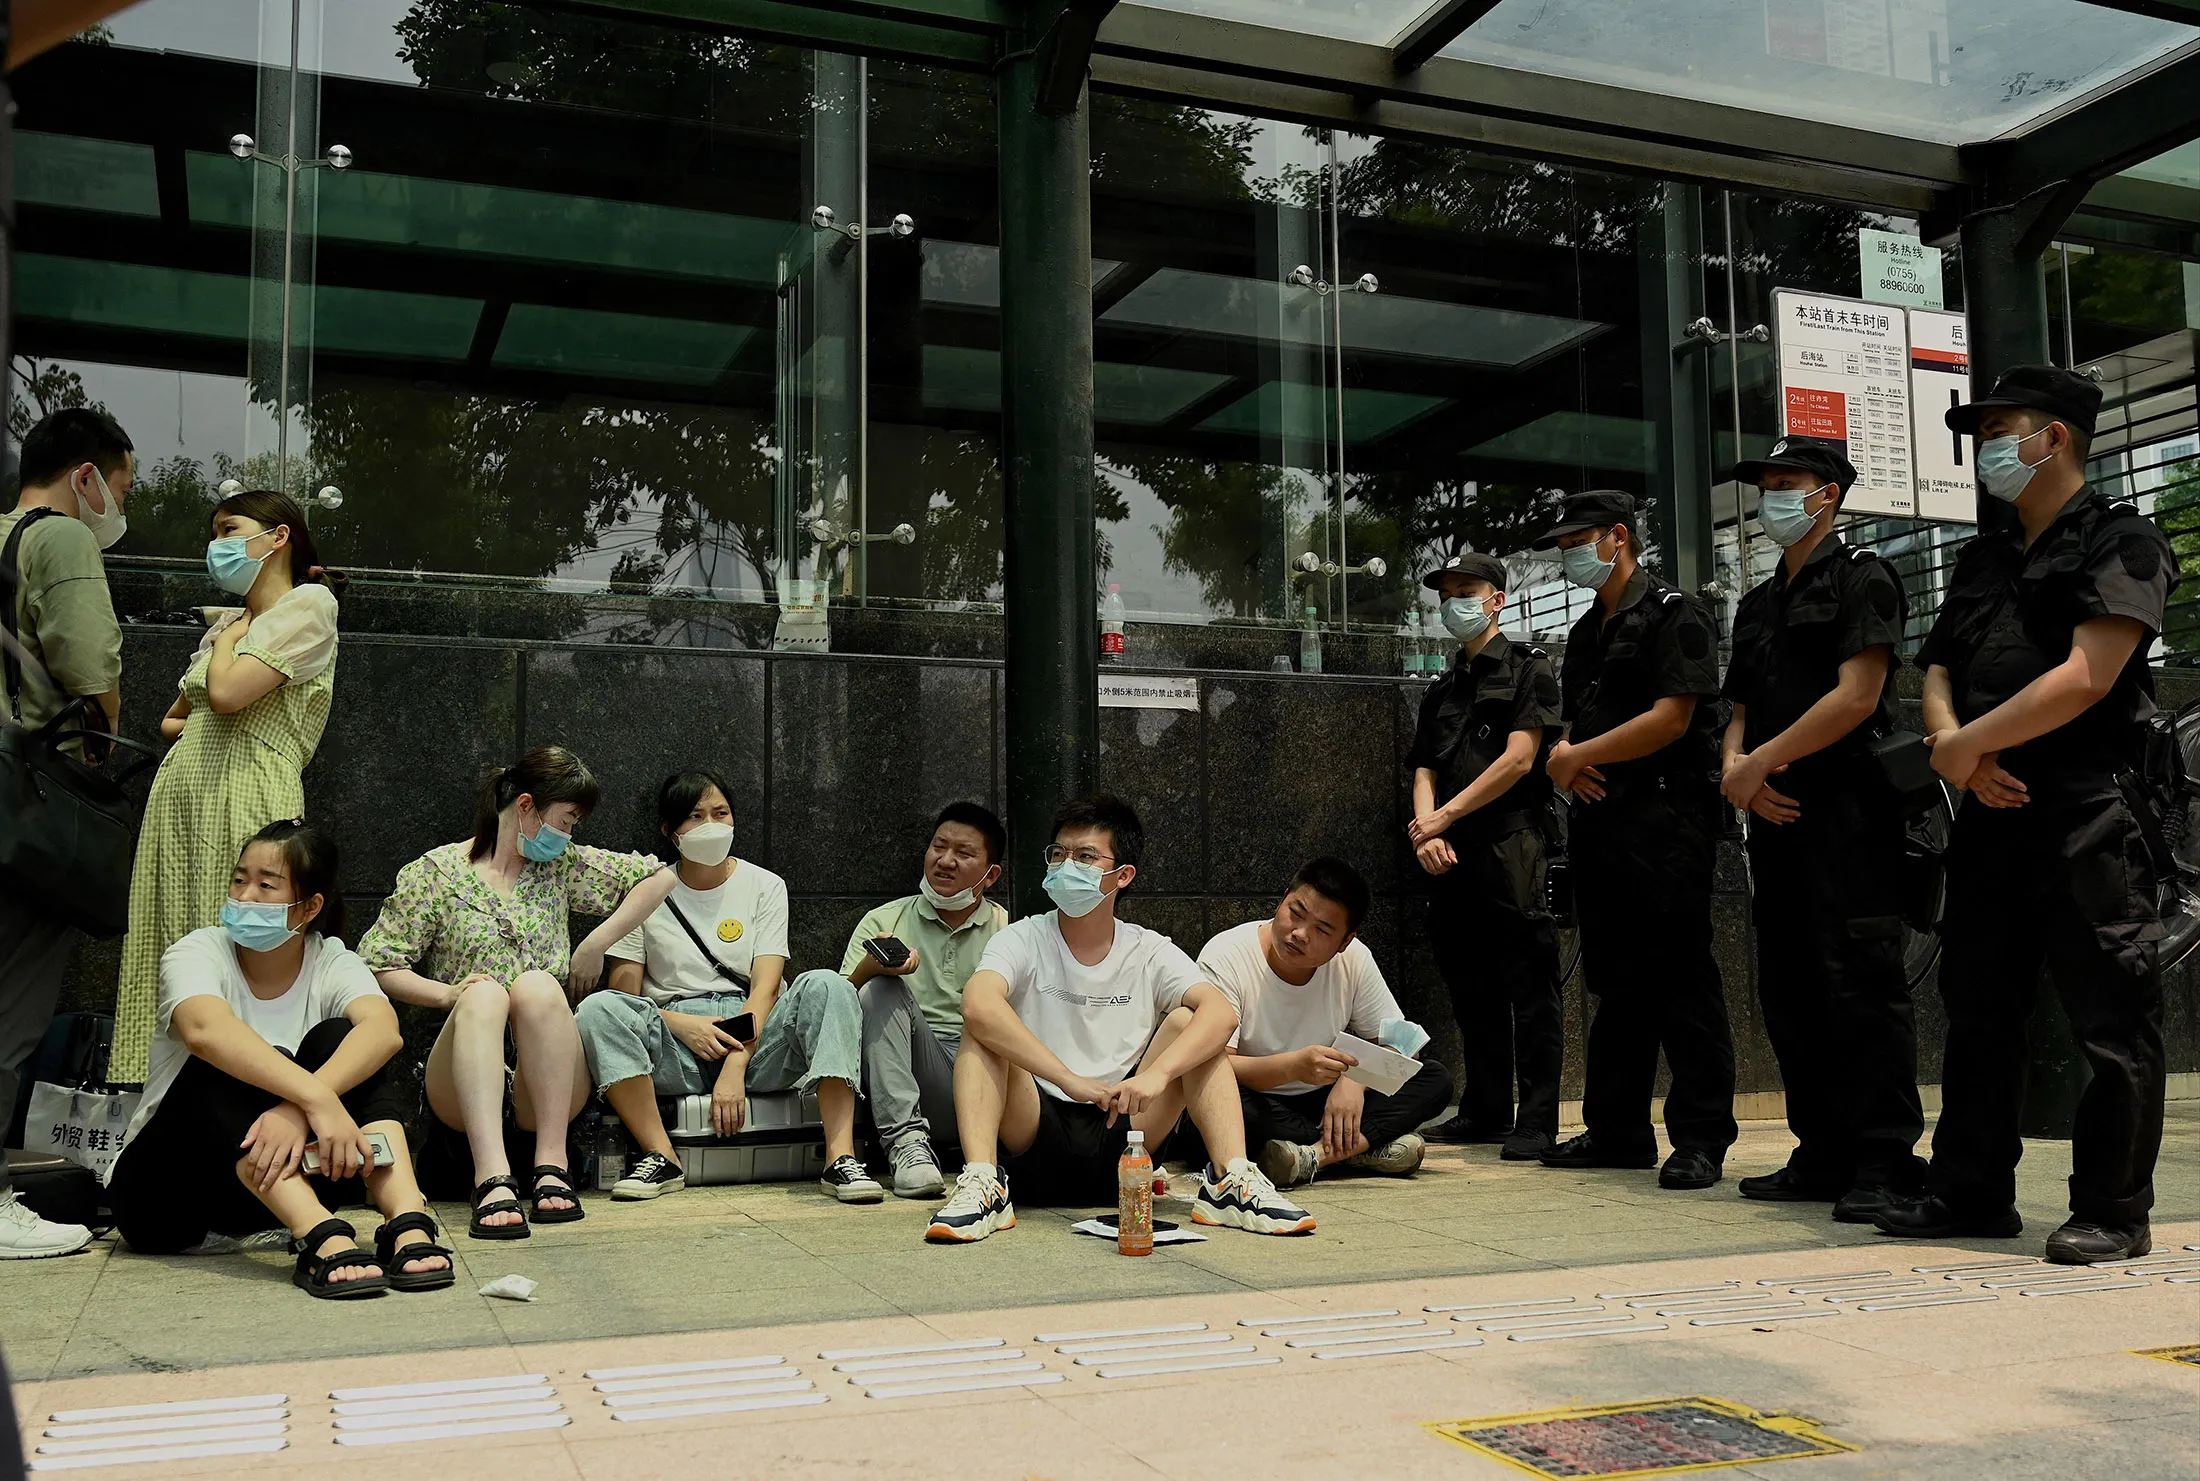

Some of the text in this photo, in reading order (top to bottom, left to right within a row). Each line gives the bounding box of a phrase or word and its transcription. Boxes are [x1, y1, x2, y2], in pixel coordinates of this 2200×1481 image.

[1877, 240, 1924, 259] 服务热线
[1891, 257, 1911, 265] Hotline
[1887, 266, 1917, 281] (0755)
[1880, 279, 1925, 294] 88960600
[1796, 304, 1889, 331] 本站首末车时间
[1801, 350, 1824, 362] 后海站
